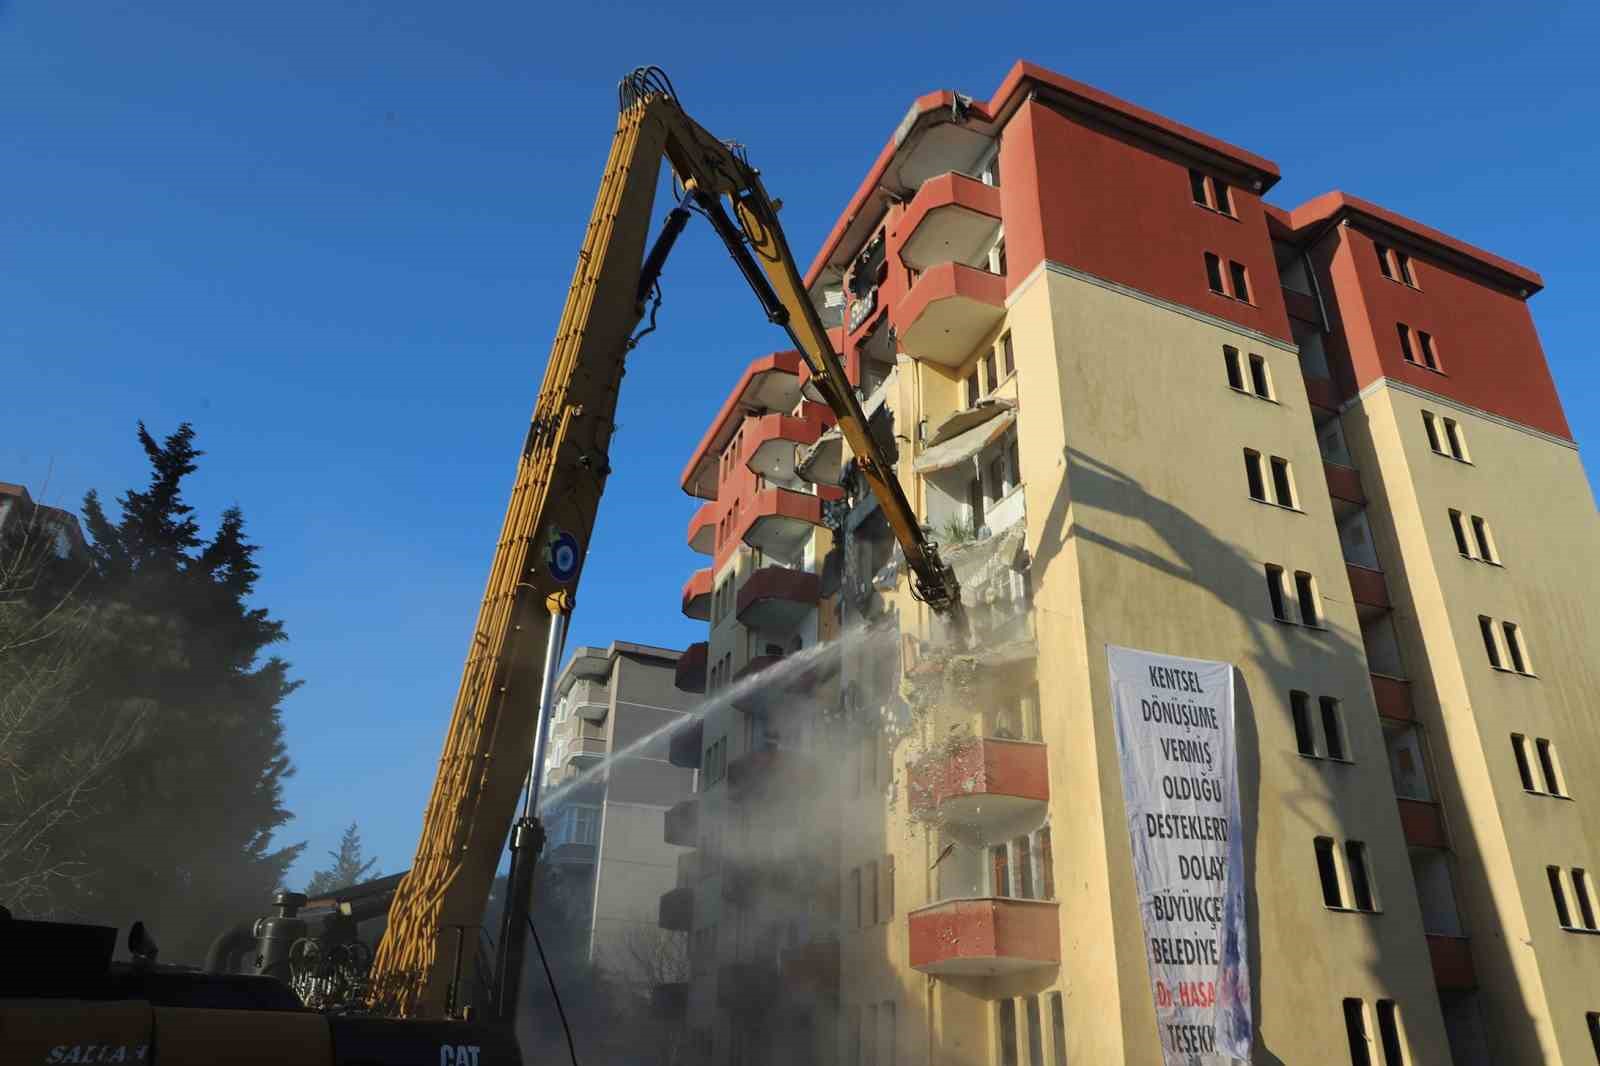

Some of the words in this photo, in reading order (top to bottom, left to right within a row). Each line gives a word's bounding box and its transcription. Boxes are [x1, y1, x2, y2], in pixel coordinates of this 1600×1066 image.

[1149, 665, 1204, 693] KENTSEL
[1141, 695, 1219, 733] DÖNÜŞÜME
[1160, 735, 1213, 771] VERMİŞ
[1162, 772, 1222, 803] OLDUĞU
[1152, 931, 1218, 965] BELEDİYE
[440, 1044, 480, 1066] CAT
